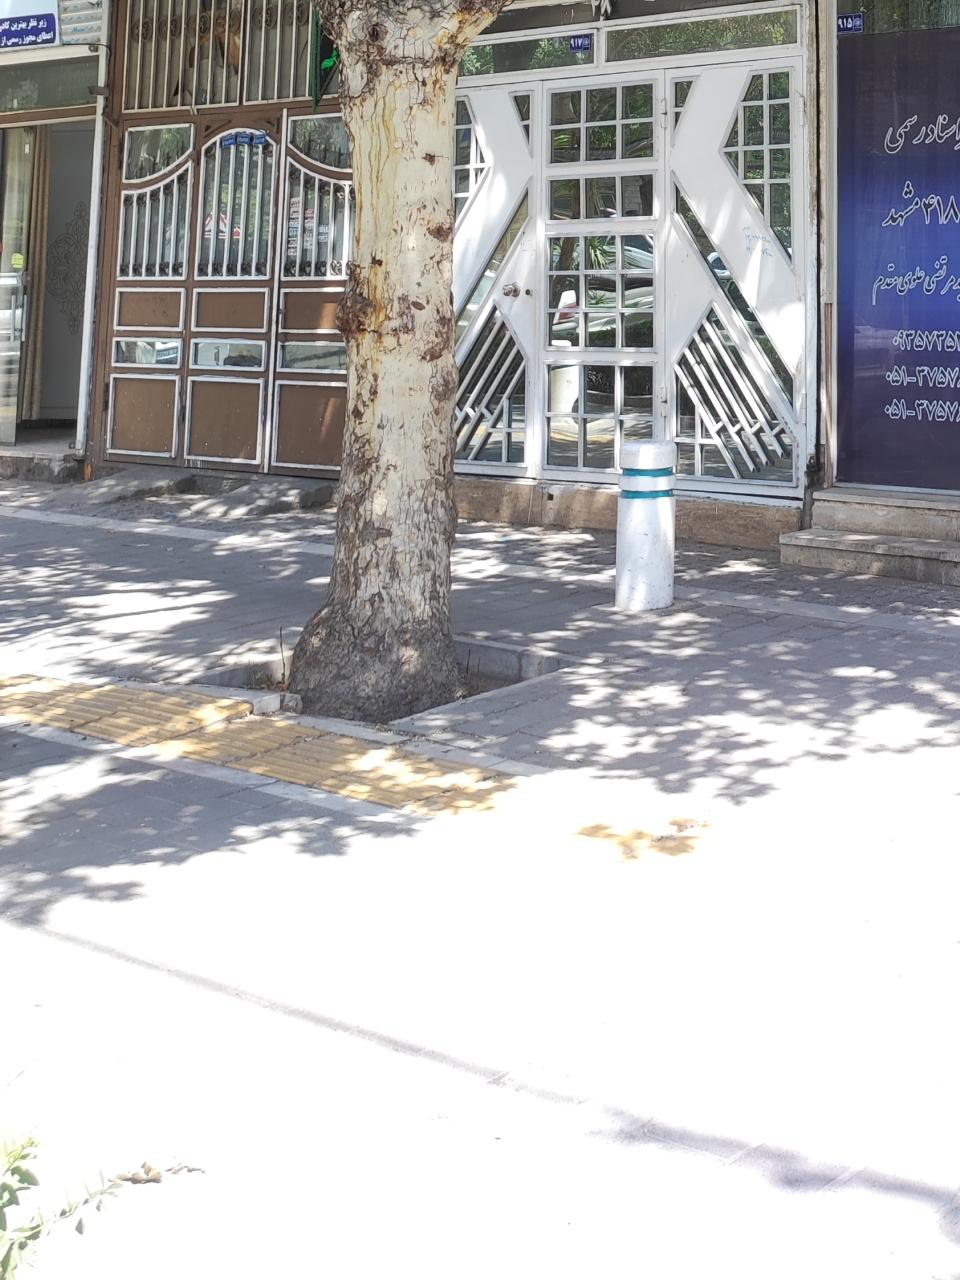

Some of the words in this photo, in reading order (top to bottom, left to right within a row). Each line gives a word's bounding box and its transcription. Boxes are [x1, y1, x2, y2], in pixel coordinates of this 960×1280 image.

[11, 20, 28, 31] بهترین
[27, 17, 38, 30] نظر
[38, 18, 48, 29] زیر
[838, 17, 853, 29] ۹۱۵
[884, 114, 926, 154] رسمی
[882, 180, 921, 227] مشهد
[921, 194, 960, 225] ۴۱۸
[872, 263, 899, 306] مقدم
[896, 266, 926, 296] علوی
